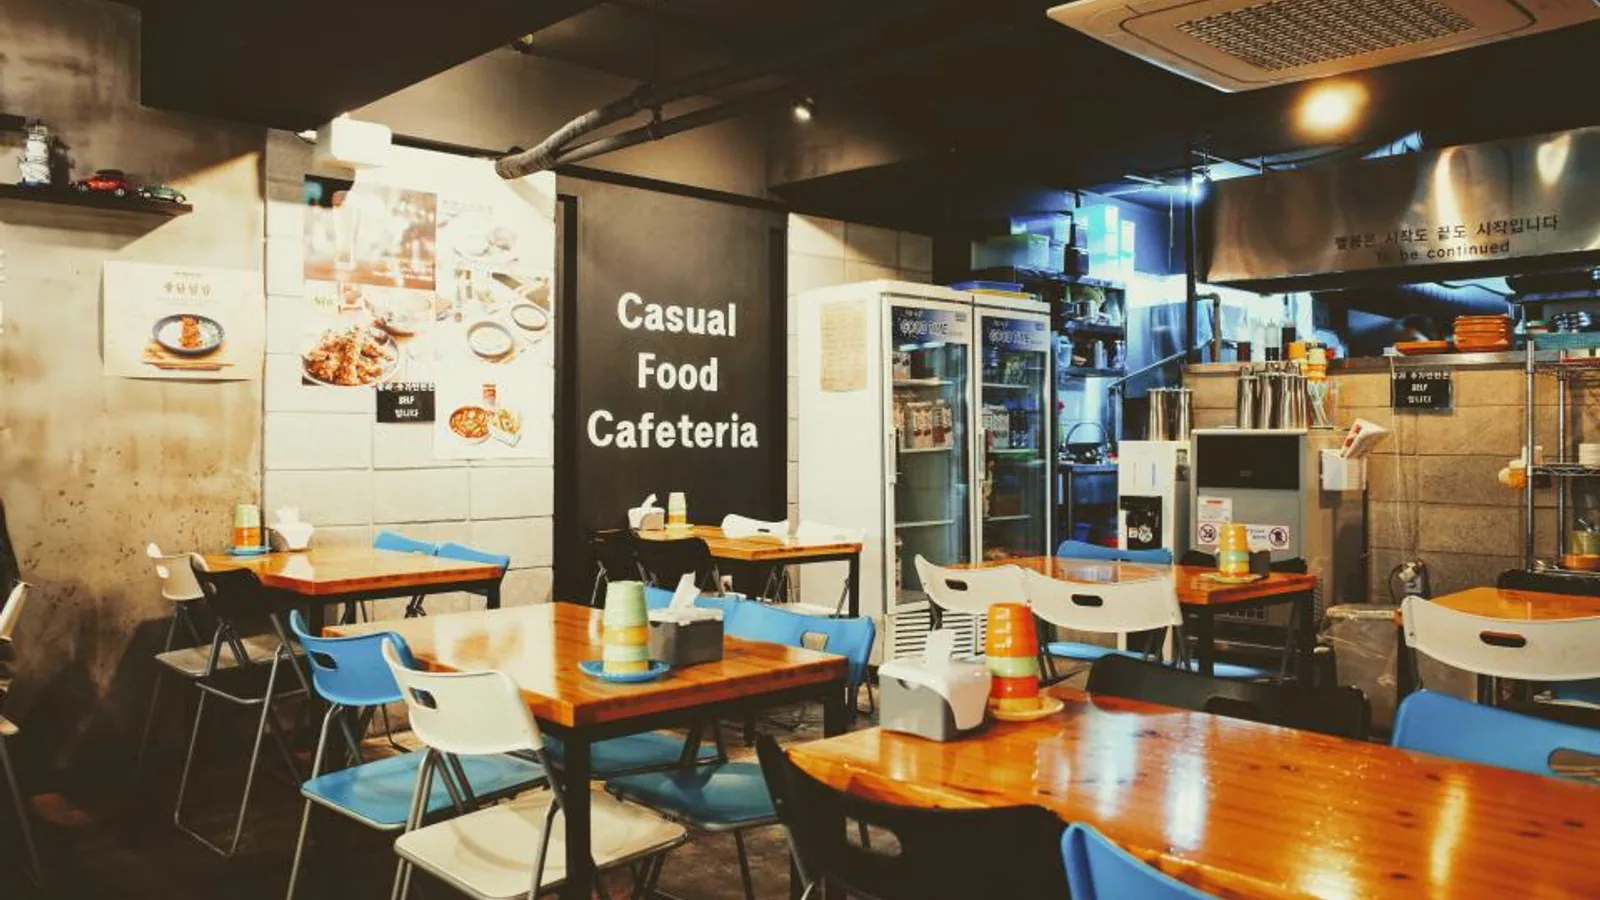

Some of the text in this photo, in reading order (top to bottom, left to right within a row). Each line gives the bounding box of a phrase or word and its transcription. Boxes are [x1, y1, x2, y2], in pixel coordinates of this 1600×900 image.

[1384, 227, 1428, 246] 시작도
[1476, 214, 1559, 236] 시작입니다
[1402, 248, 1418, 262] be
[1427, 240, 1510, 259] continued
[617, 292, 736, 337] Casual
[638, 352, 718, 392] Food
[586, 409, 759, 449] Cafeteria
